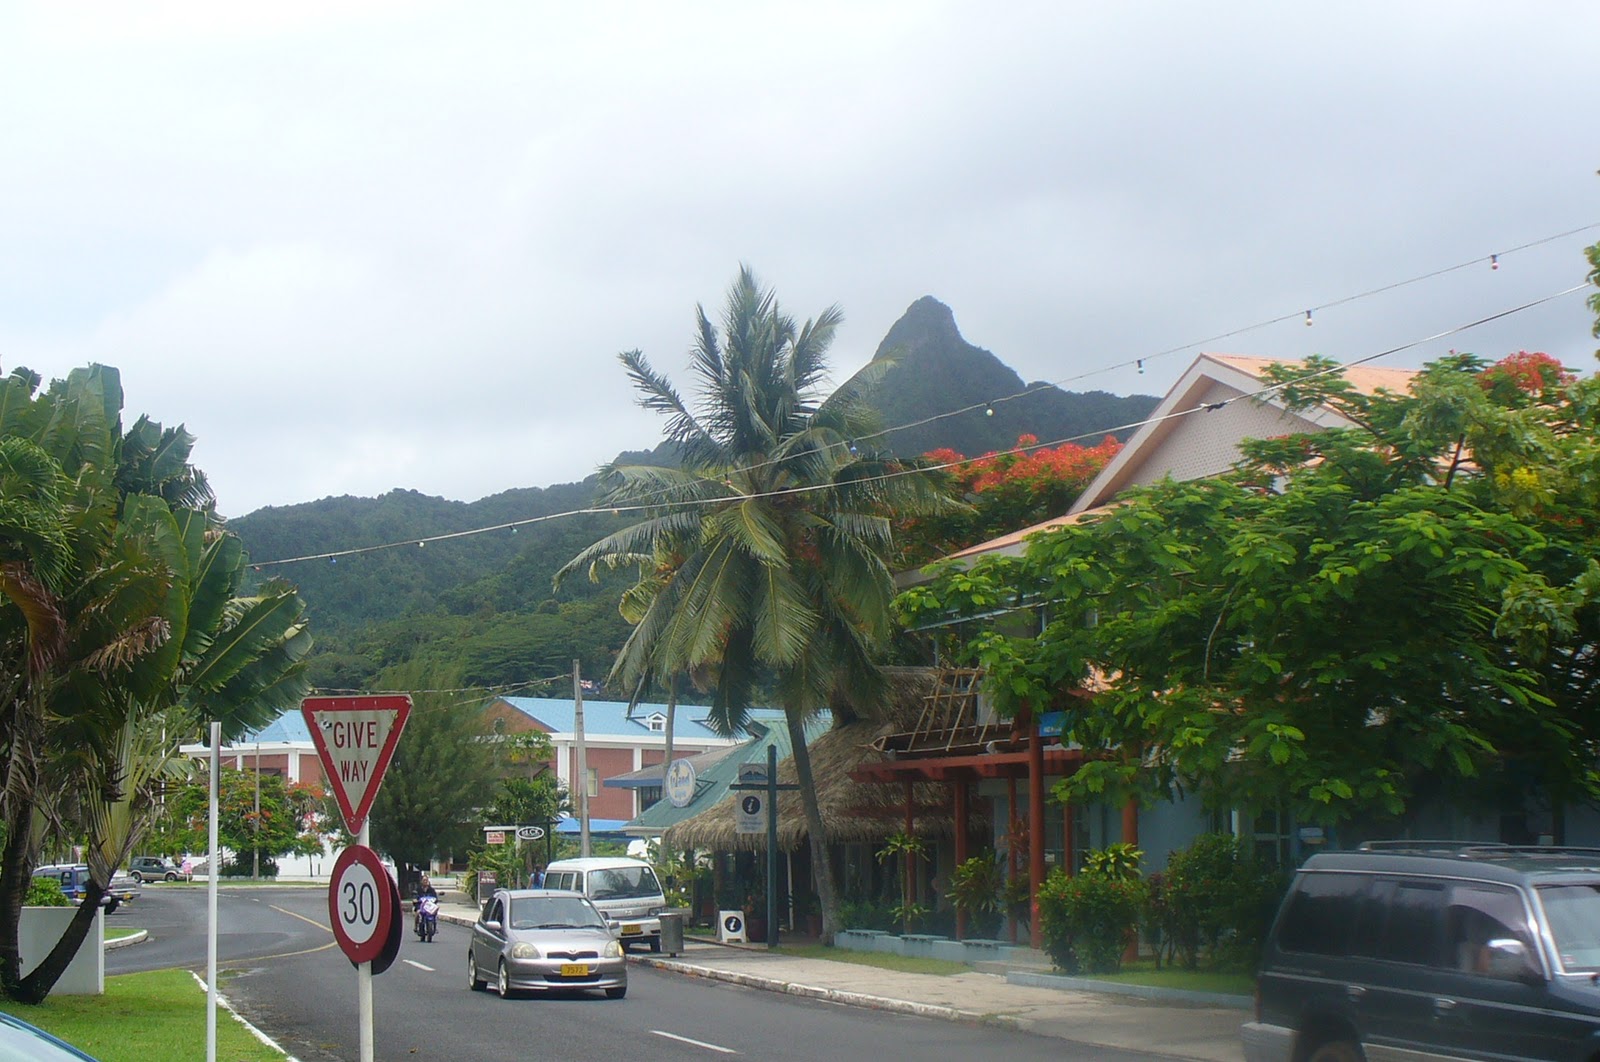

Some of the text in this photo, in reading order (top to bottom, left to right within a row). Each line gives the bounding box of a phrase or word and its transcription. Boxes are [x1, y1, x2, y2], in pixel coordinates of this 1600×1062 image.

[333, 721, 378, 749] GIVE
[340, 760, 369, 782] WAY
[343, 882, 374, 925] 30
